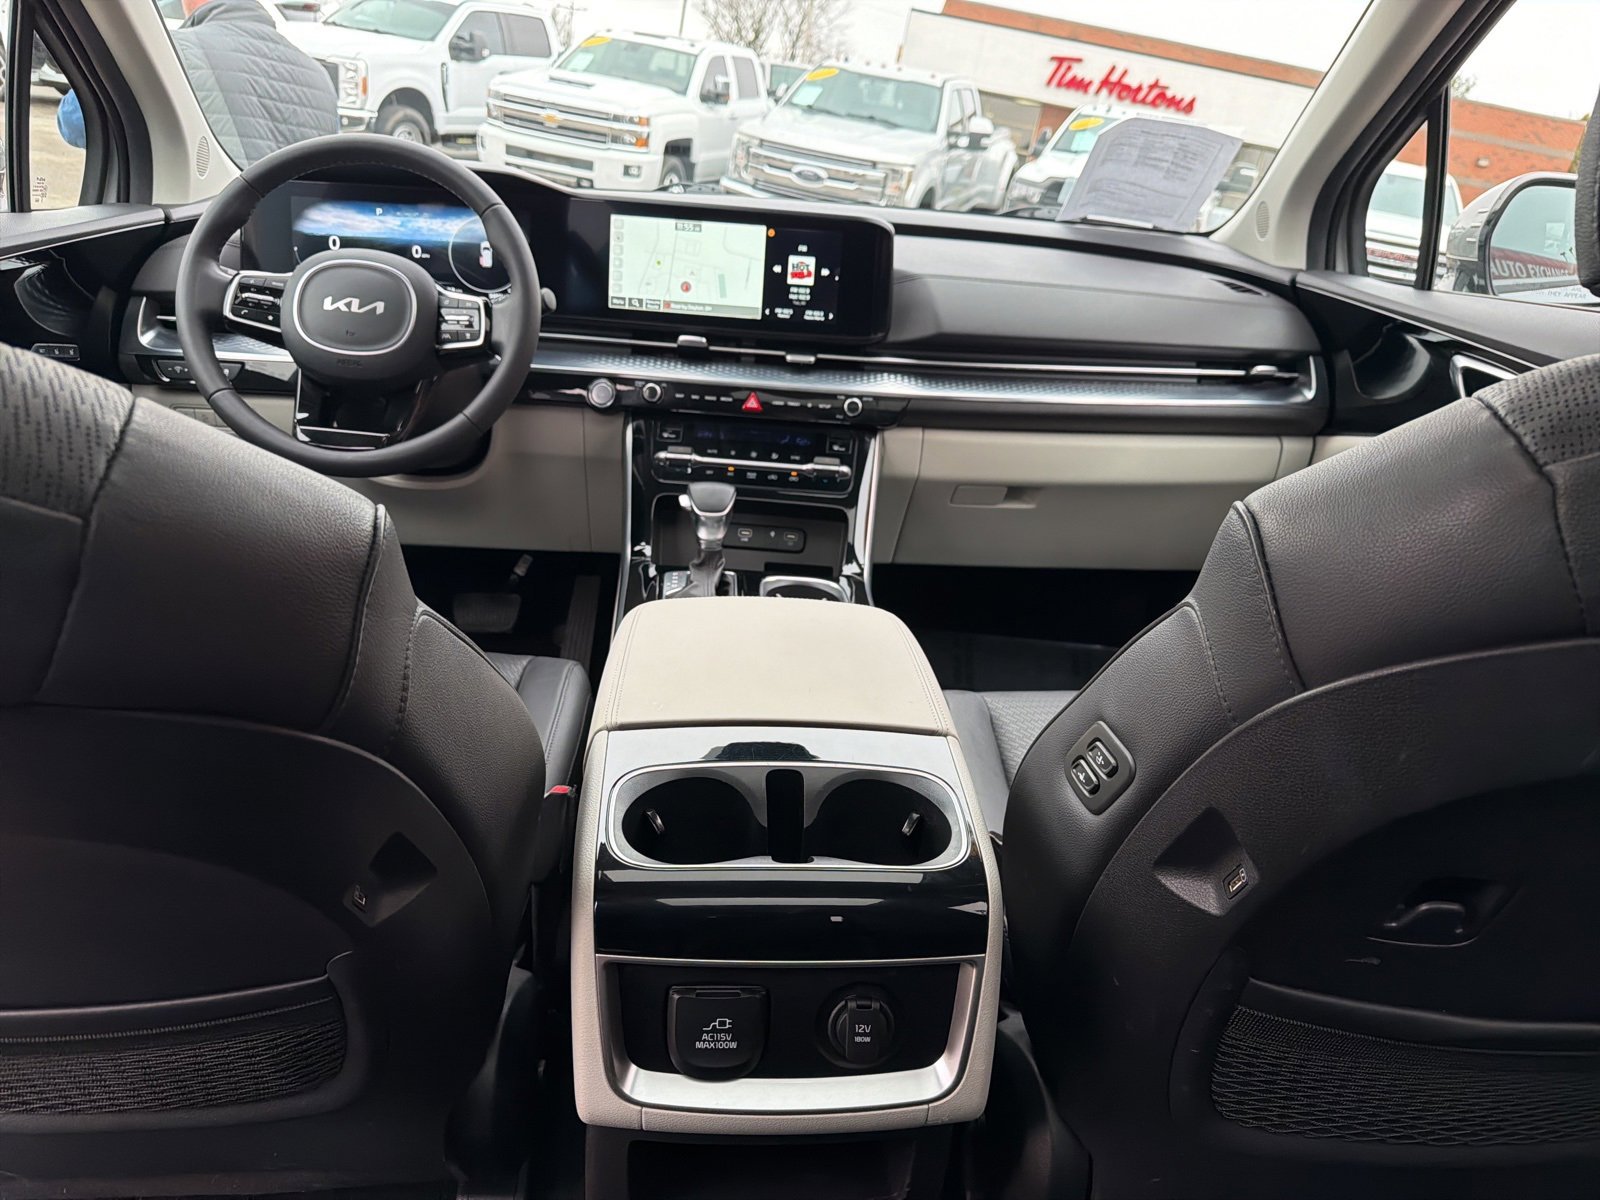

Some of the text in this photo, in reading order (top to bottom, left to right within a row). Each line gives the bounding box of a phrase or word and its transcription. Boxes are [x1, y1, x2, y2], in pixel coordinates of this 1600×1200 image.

[1046, 56, 1196, 114] Tim Hortons
[375, 207, 383, 217] P
[327, 235, 341, 250] 0
[411, 245, 422, 258] 0
[1490, 258, 1527, 278] AUTO
[323, 295, 385, 315] KIA
[855, 1024, 871, 1033] 12V
[701, 1032, 733, 1041] AC115V
[695, 1041, 738, 1049] MAX100W
